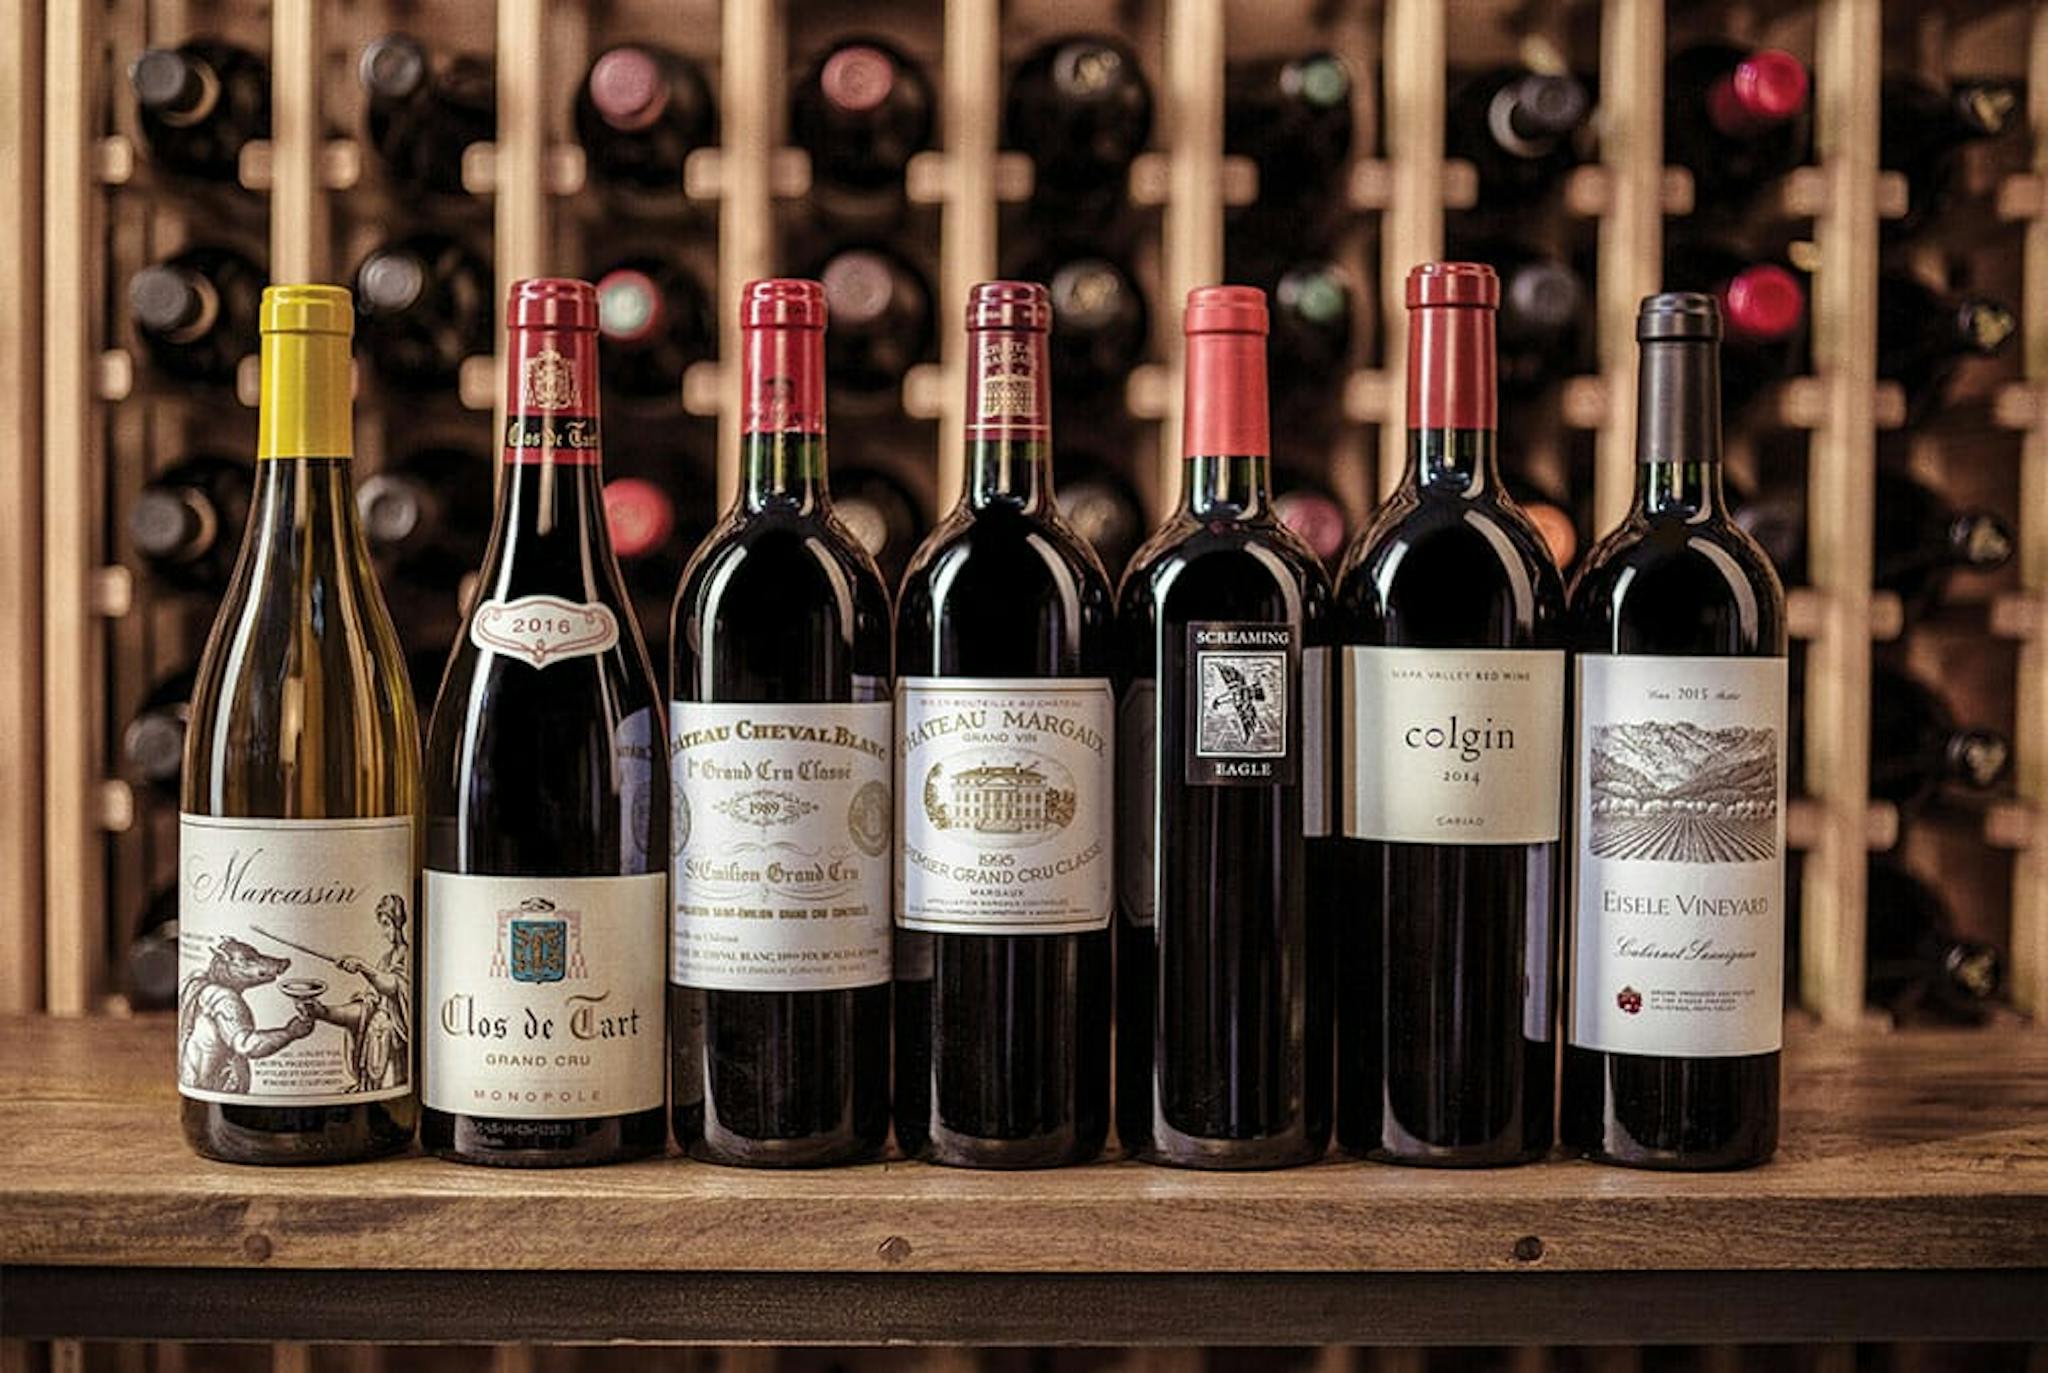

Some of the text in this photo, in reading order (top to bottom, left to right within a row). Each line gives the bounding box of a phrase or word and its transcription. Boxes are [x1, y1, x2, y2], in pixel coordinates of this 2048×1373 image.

[512, 619, 572, 634] 2016
[1196, 631, 1289, 644] SCREAMING
[1476, 672, 1499, 681] RED
[1503, 672, 1530, 681] WINE
[736, 719, 832, 744] CHEVAL
[835, 725, 886, 762] BLANC
[962, 732, 1008, 743] GRAND
[1405, 715, 1514, 763] colgin
[1215, 763, 1271, 776] EAGLE
[1443, 771, 1480, 786] 2014
[766, 861, 824, 884] Grand
[953, 866, 1014, 884] GRAND
[1018, 865, 1054, 883] CRU
[970, 889, 1024, 897] MARGAUX
[1603, 890, 1670, 916] EISELE
[441, 990, 640, 1041] Clos de Tart
[485, 1054, 591, 1067] GRAND CRU
[473, 1089, 601, 1103] MONOPOLE
